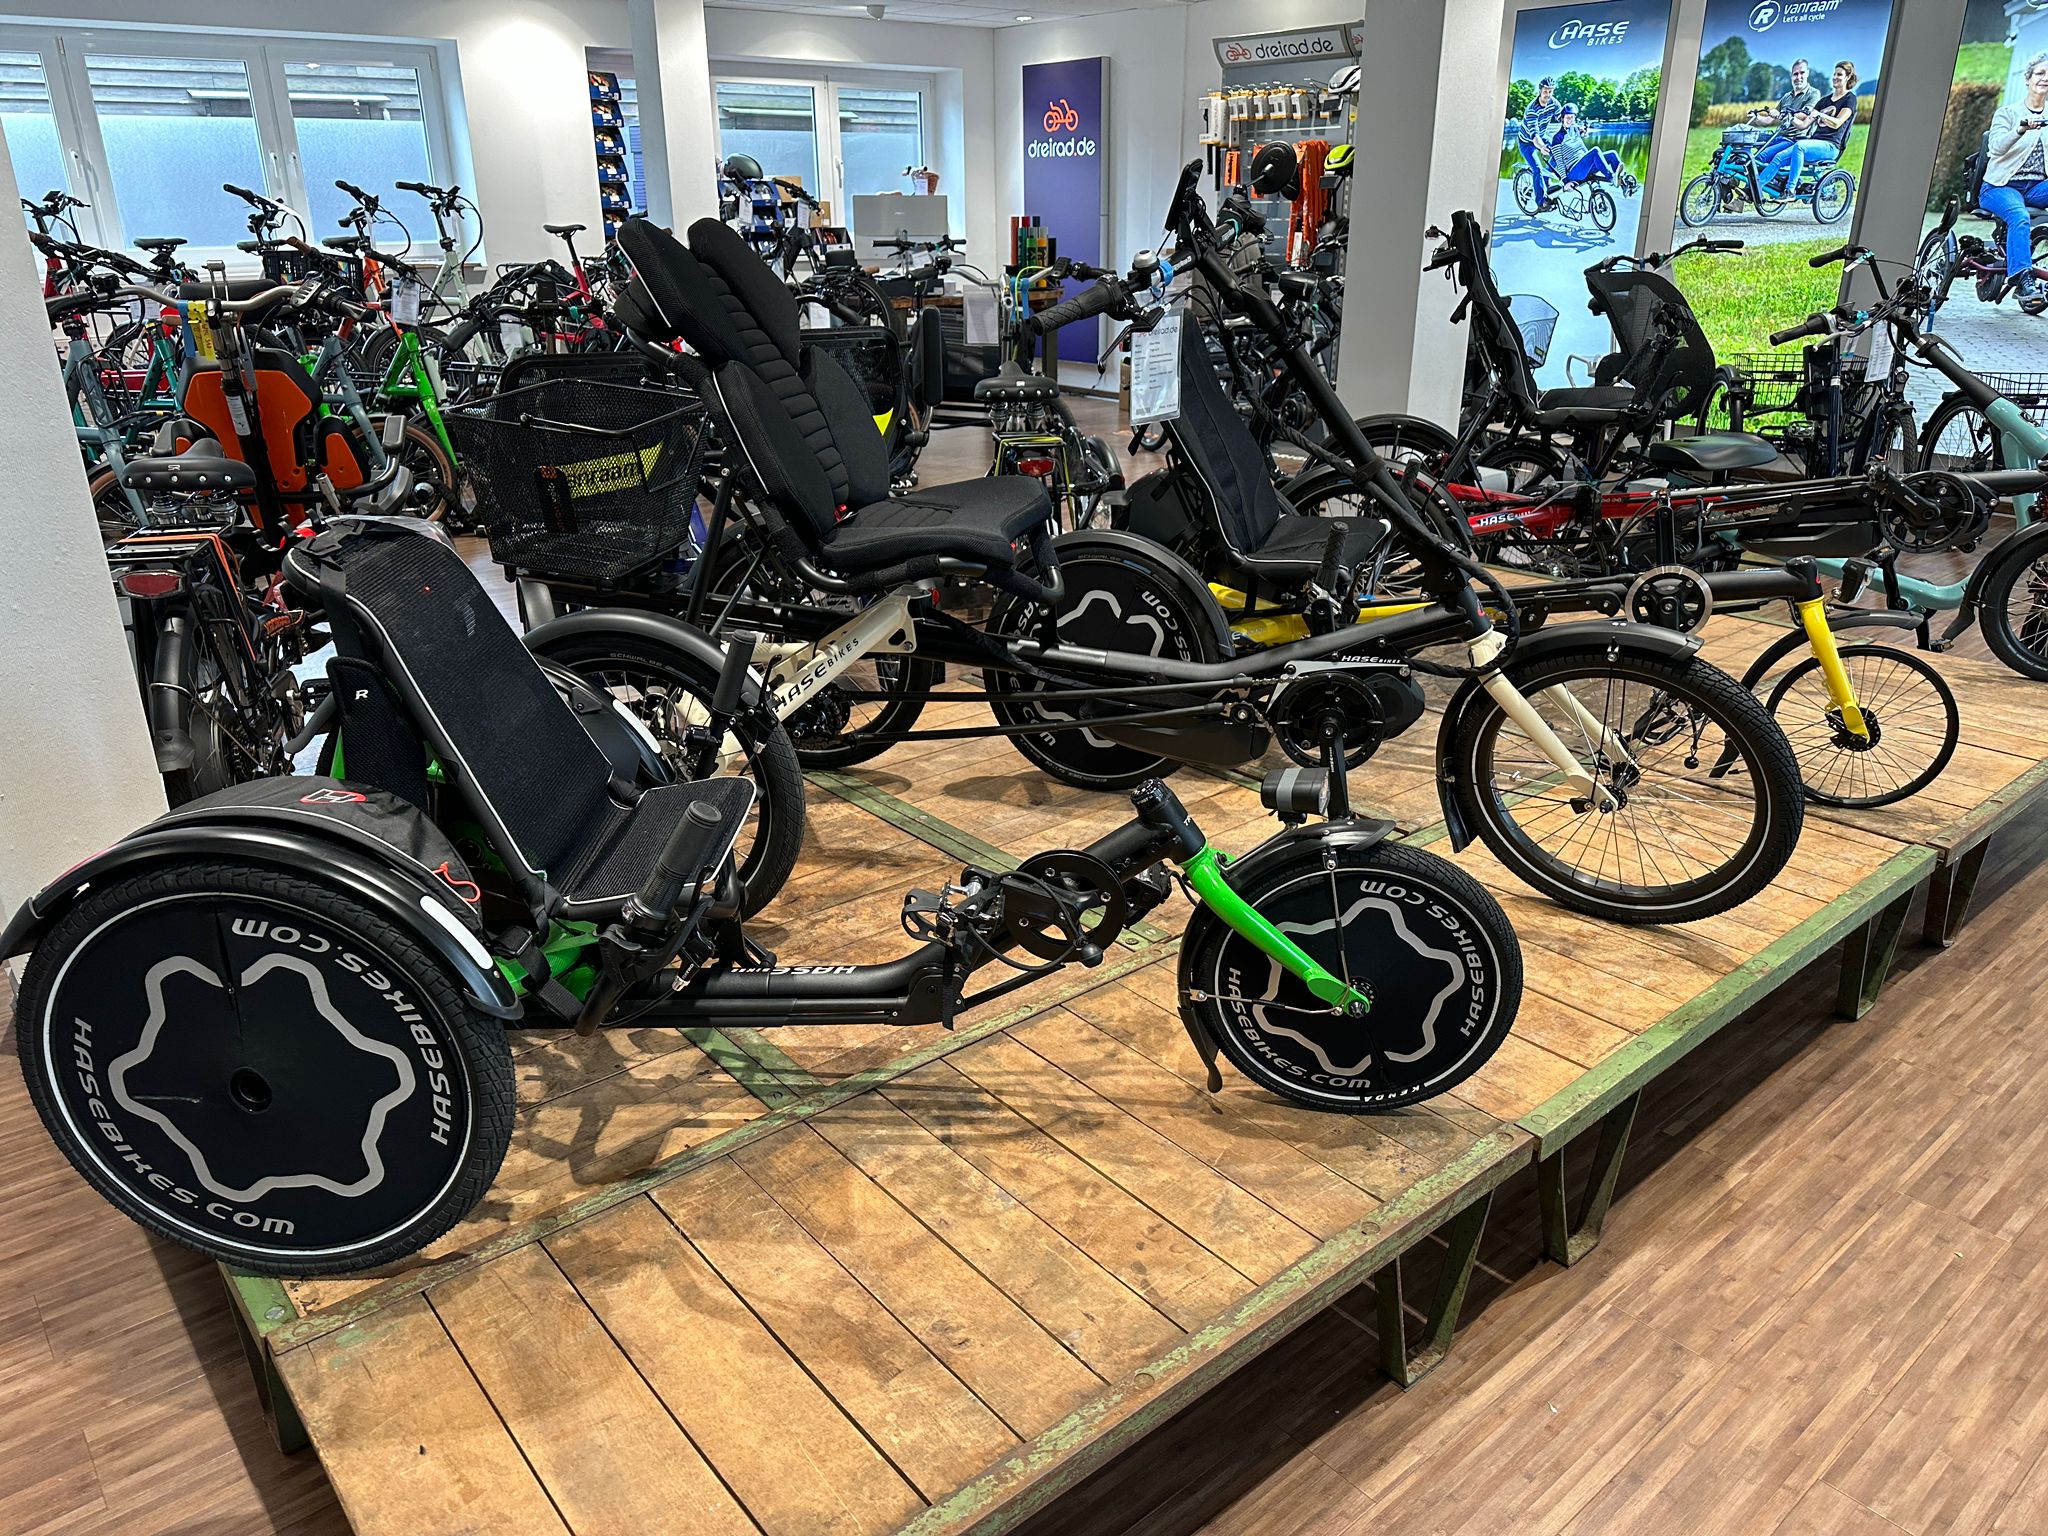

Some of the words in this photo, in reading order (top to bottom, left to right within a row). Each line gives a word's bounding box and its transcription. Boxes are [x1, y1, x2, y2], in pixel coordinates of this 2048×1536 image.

[1784, 0, 1839, 14] vanraam
[1783, 14, 1798, 23] Let's
[1799, 14, 1807, 22] all
[1808, 13, 1826, 22] cycle
[1560, 21, 1630, 40] HASE
[1255, 37, 1334, 59] dreirad.de
[1586, 35, 1624, 46] BIKES
[1028, 136, 1095, 158] dreirad.de
[1480, 513, 1514, 526] HASE
[610, 652, 663, 667] SCHWALBE
[827, 638, 860, 668] BIKES
[1341, 655, 1380, 663] HASE
[1364, 1084, 1420, 1103] KENDA
